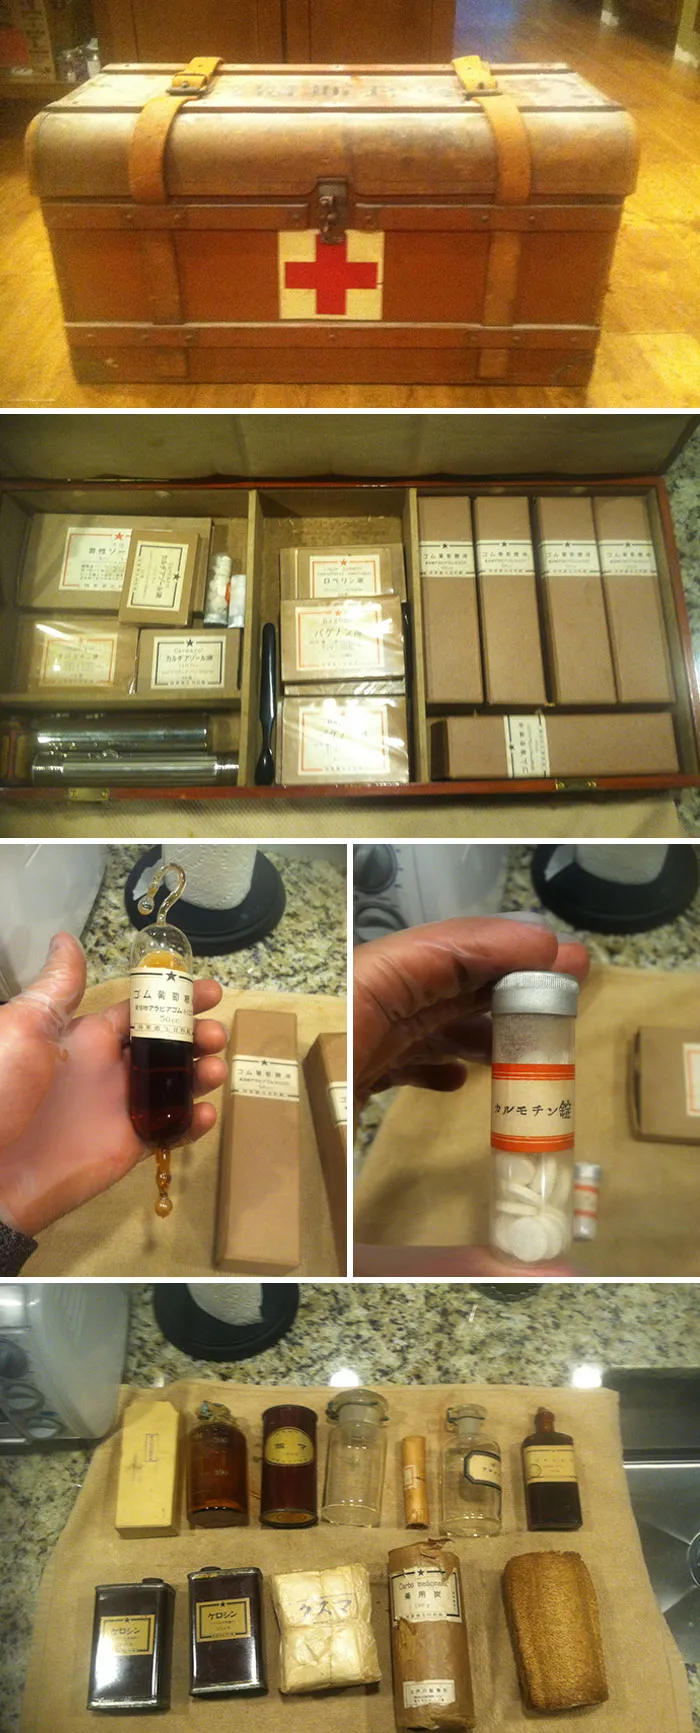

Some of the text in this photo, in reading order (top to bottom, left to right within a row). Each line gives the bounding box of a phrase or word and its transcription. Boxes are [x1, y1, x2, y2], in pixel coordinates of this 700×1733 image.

[494, 1100, 572, 1119] カルモチン錠
[208, 1611, 237, 1620] ケロシン
